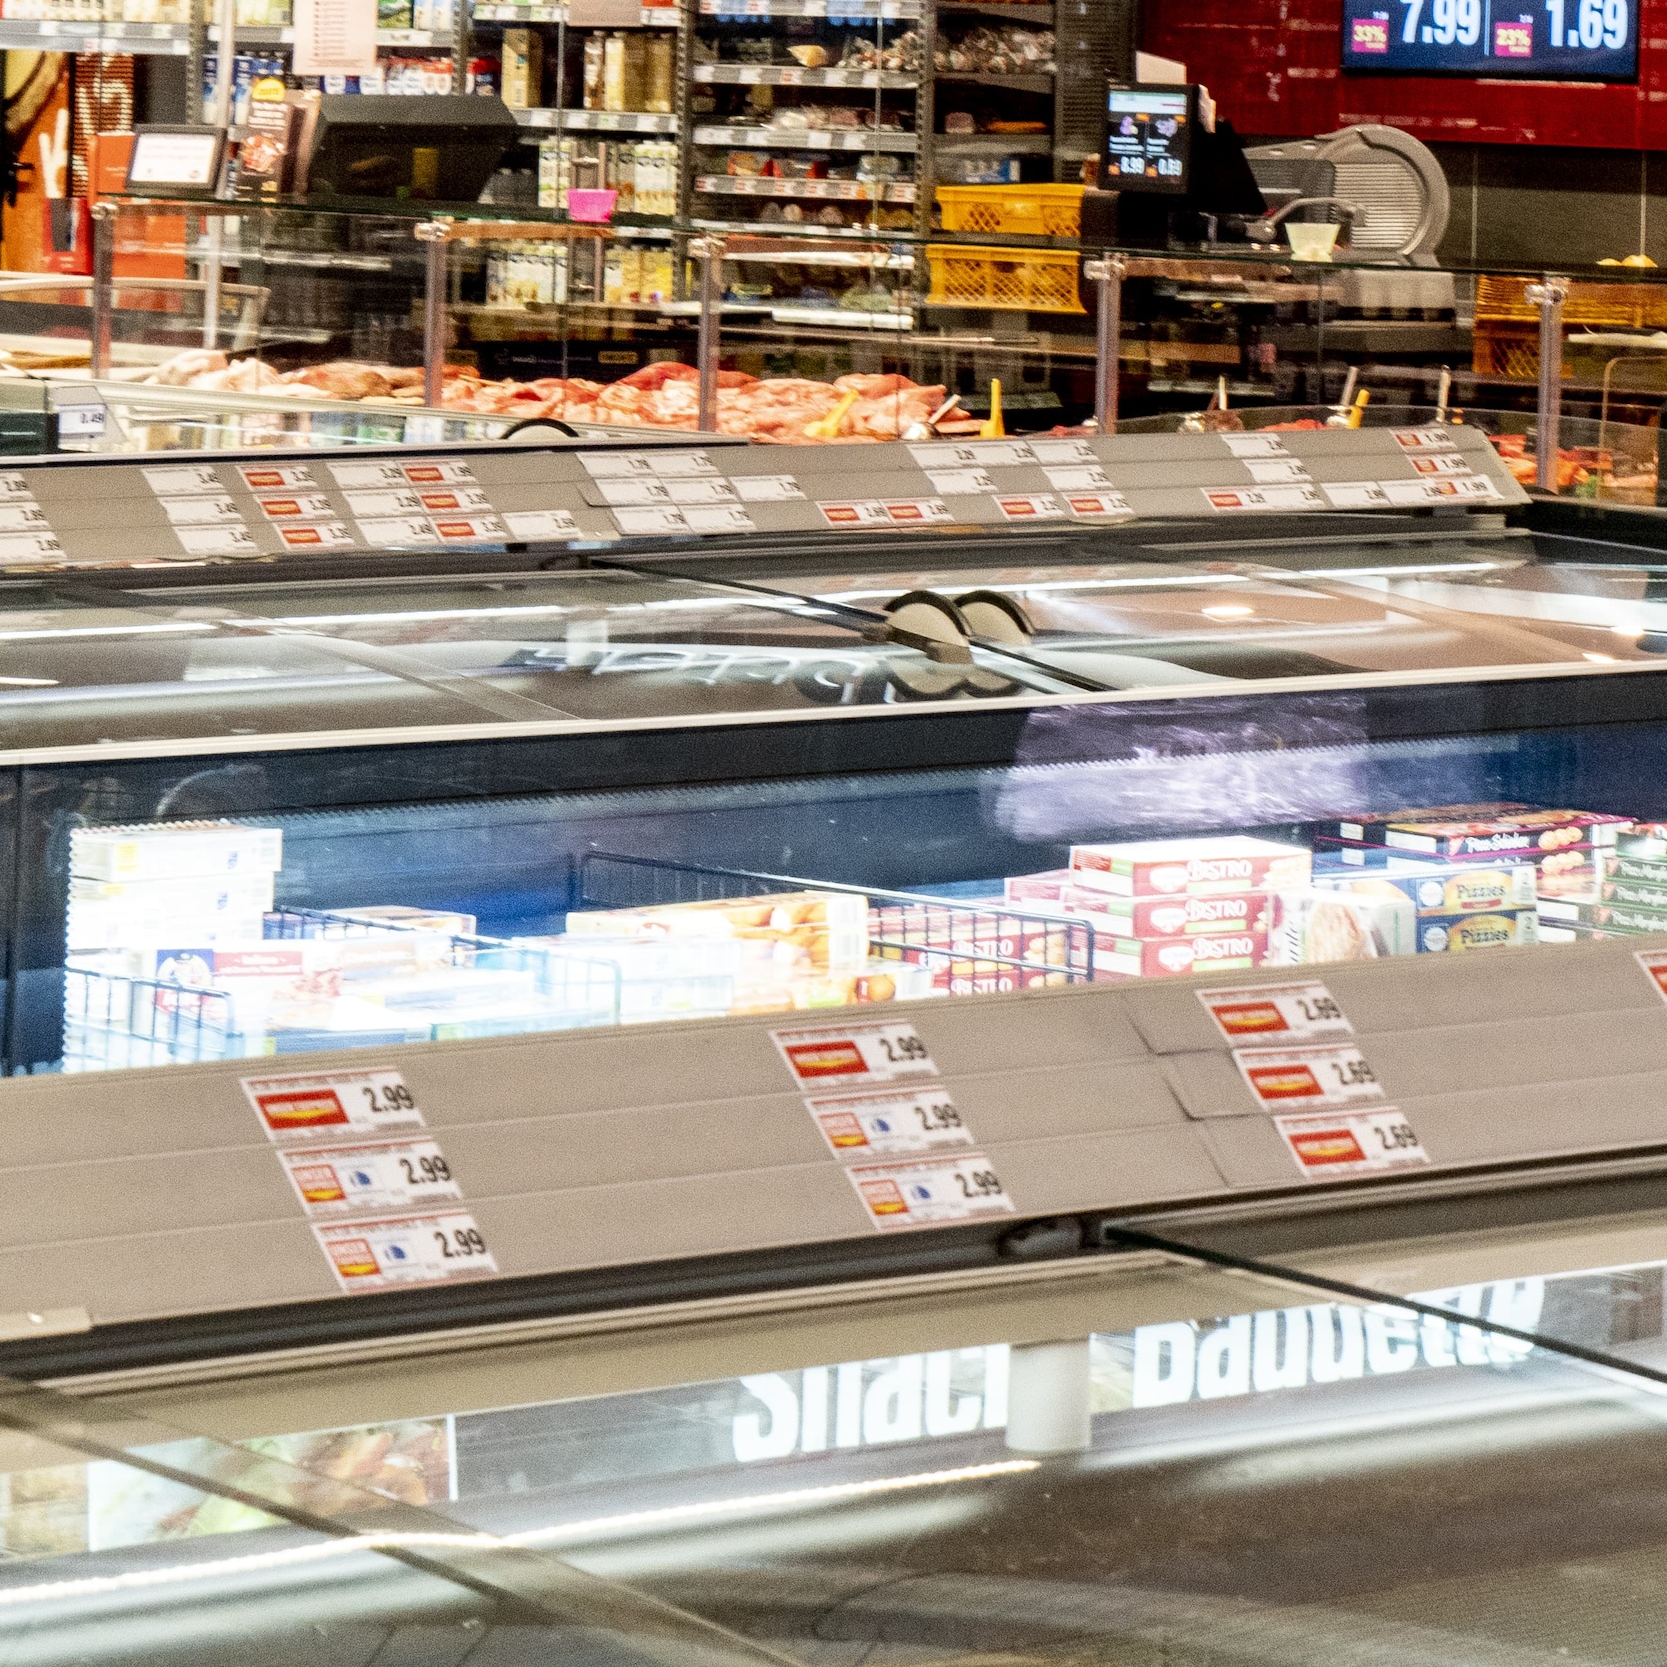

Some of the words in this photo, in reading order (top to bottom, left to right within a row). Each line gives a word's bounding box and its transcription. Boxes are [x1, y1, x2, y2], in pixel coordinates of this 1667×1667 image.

[1120, 156, 1145, 174] 8.99
[1425, 433, 1450, 442] 1.99
[1442, 458, 1467, 469] 1.99
[1462, 481, 1487, 492] 1.99
[1187, 859, 1252, 881] BISTRO
[1456, 883, 1506, 899] Pizzies
[1185, 899, 1248, 921] BISTRO
[1461, 928, 1510, 944] Pizzies
[1192, 937, 1253, 960] BISTRO
[879, 1036, 929, 1063] 2.99
[363, 1084, 416, 1113] 2.99
[914, 1103, 963, 1131] 2.99
[1374, 1123, 1419, 1150] 2.69
[400, 1154, 452, 1185] 2.99
[954, 1169, 1003, 1198] 2.99
[434, 1227, 488, 1259] 2.99
